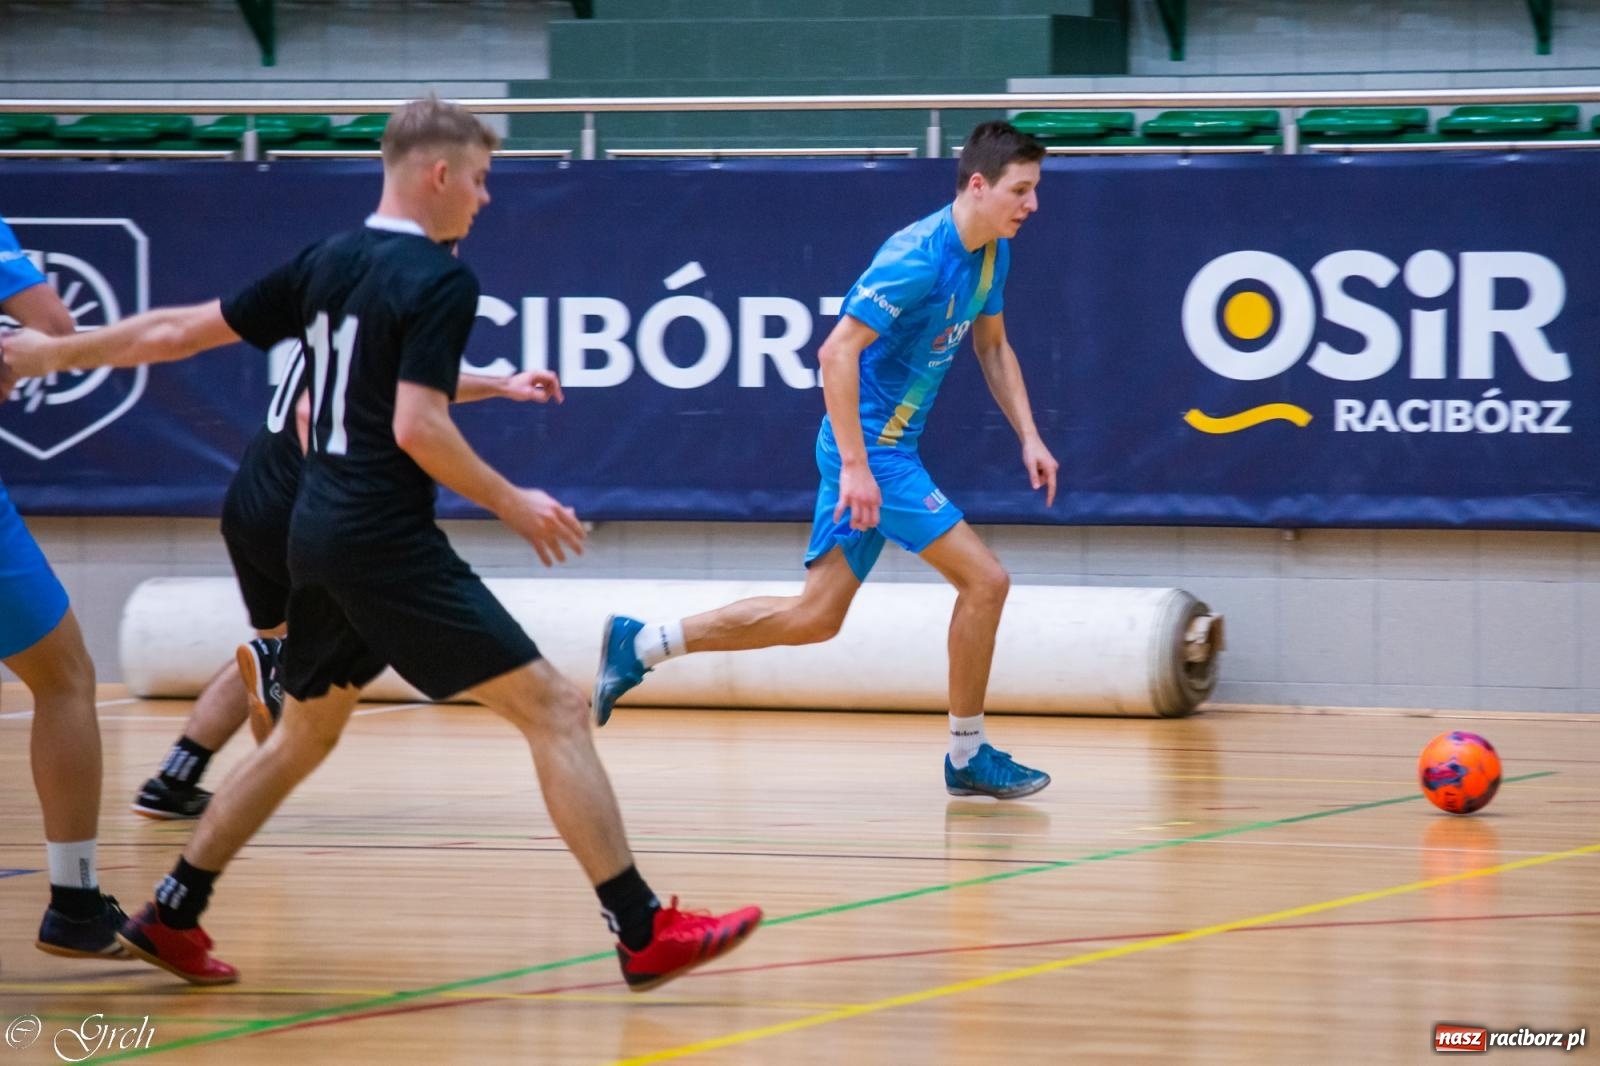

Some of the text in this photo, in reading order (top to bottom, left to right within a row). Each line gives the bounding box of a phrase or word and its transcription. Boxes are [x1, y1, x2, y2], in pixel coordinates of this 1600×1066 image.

[267, 260, 846, 389] CIBÓR
[304, 310, 359, 456] 11
[1333, 388, 1573, 434] RACIBÓRZ
